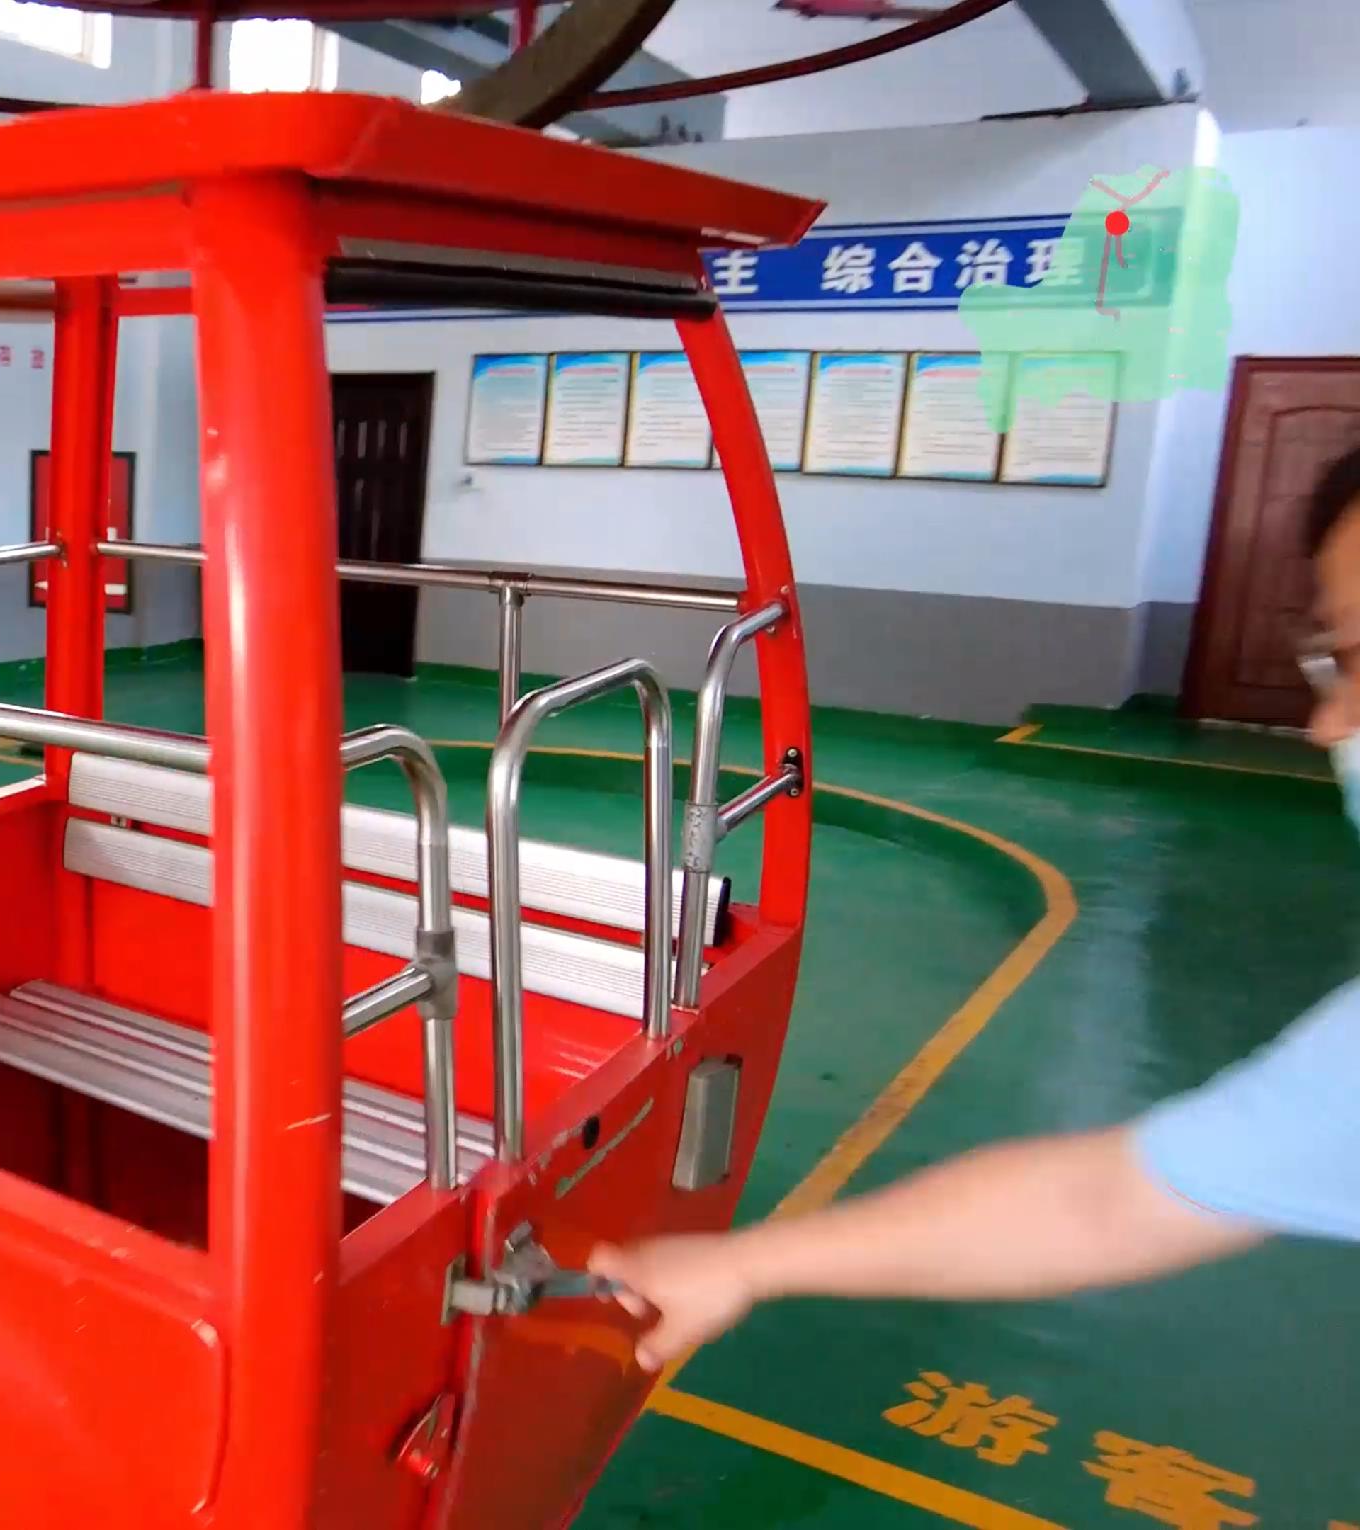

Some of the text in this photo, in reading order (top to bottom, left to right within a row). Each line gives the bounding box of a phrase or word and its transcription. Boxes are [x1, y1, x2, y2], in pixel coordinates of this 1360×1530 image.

[822, 237, 1087, 293] 综合治理
[881, 1370, 1360, 1530] 游客
